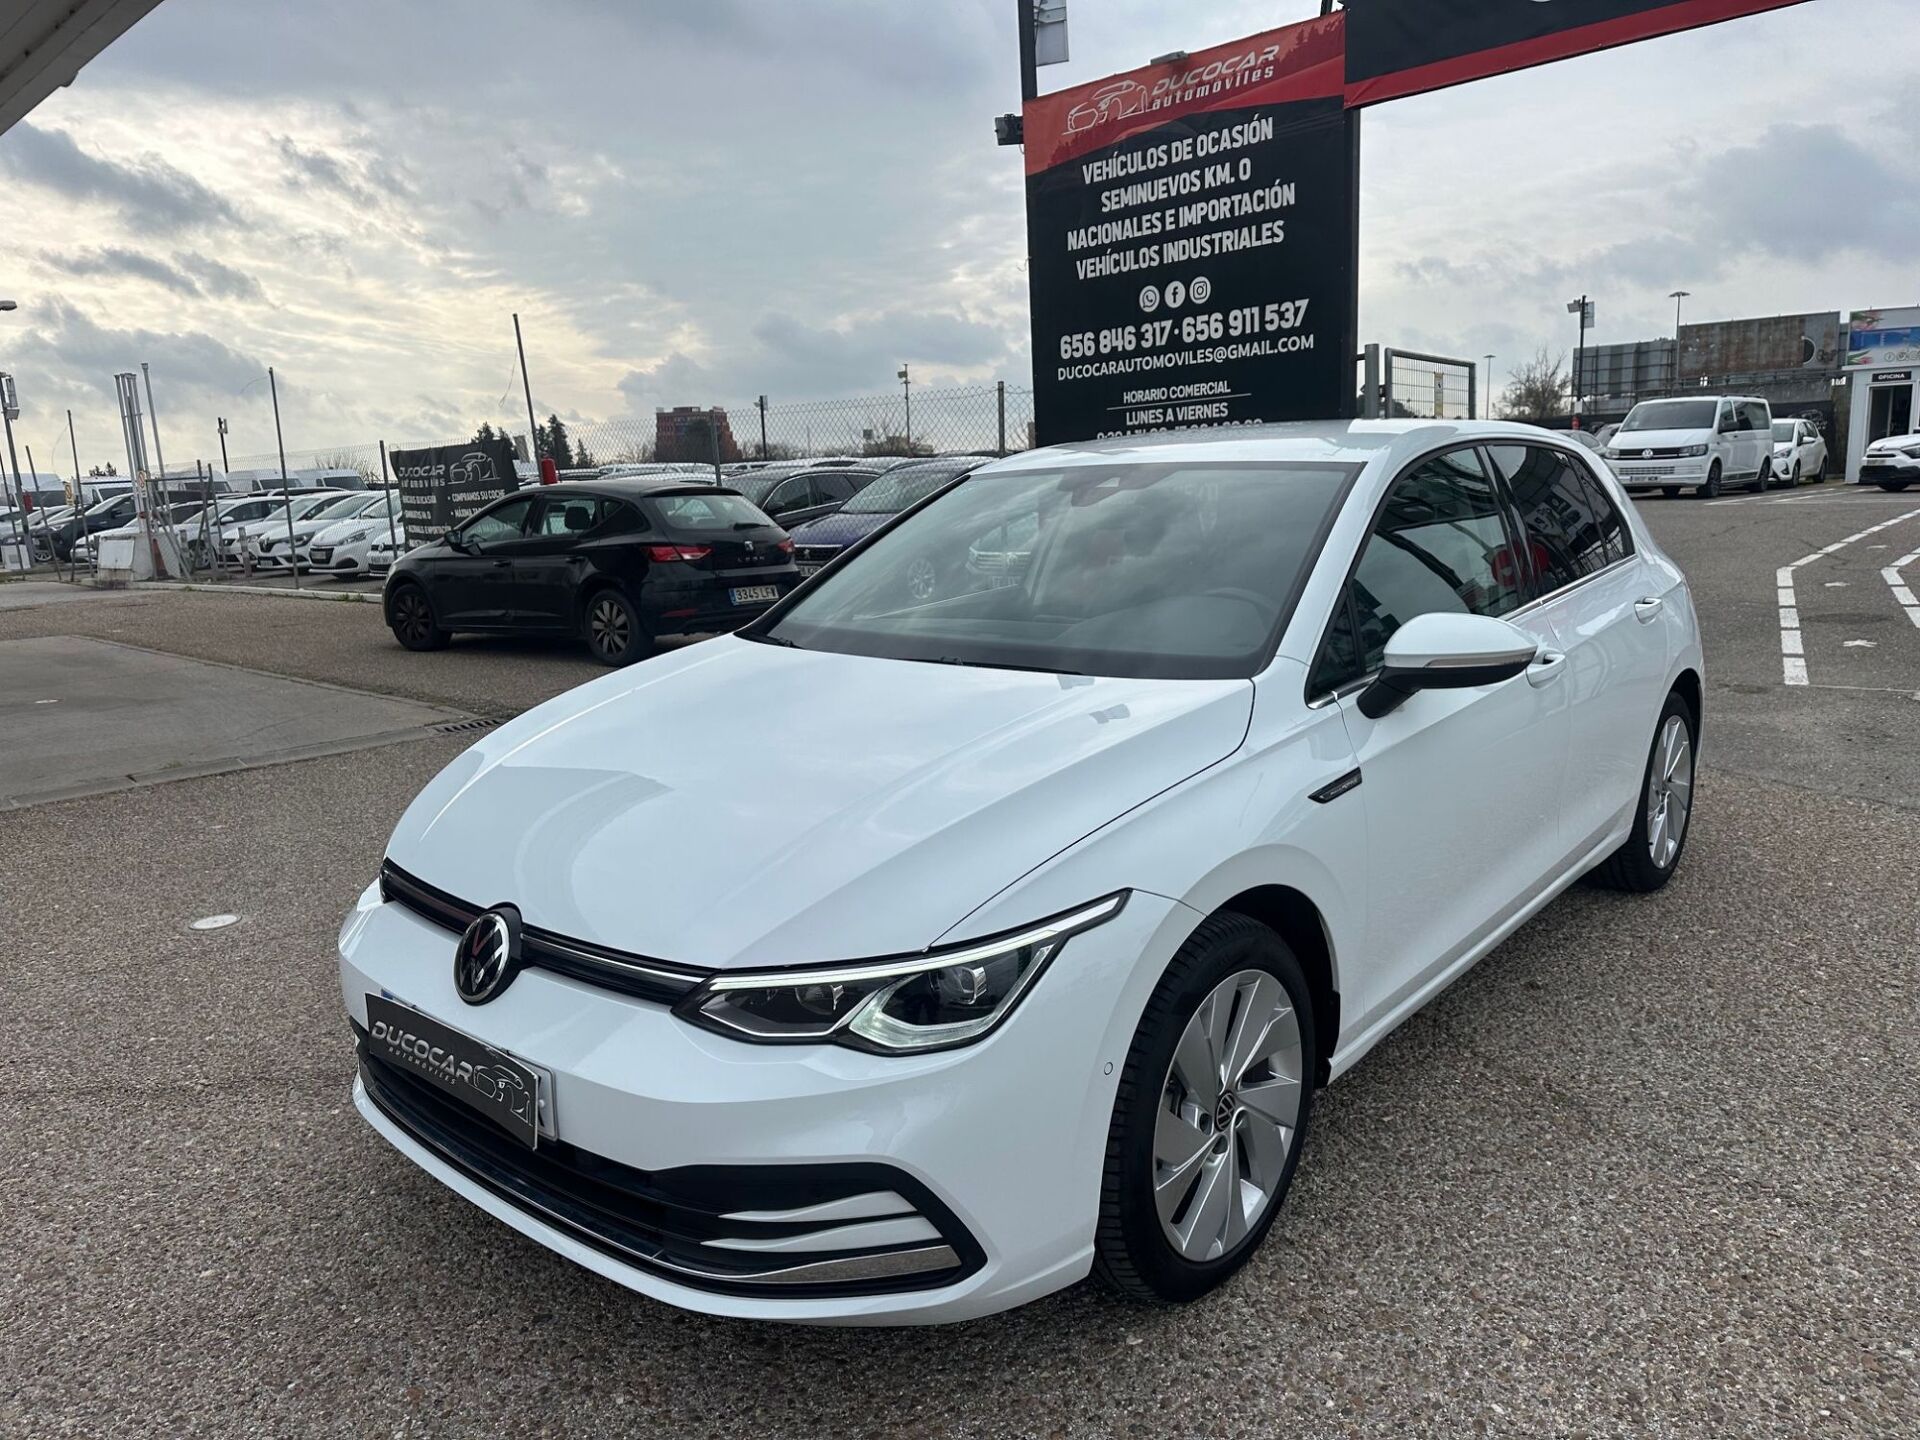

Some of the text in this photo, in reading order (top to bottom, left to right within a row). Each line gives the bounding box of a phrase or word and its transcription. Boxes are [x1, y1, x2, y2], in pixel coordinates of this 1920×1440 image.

[1152, 45, 1280, 96] DUCOCAR
[1152, 65, 1274, 110] automoviles
[1082, 113, 1273, 185] VEHÍCULOS DE OCASIÓN
[1101, 169, 1201, 213] SEMINUEVOS
[1204, 162, 1235, 189] KM.
[1067, 179, 1296, 252] NACIONALES E IMPORTACIÓN
[1076, 220, 1285, 280] VEHÍCULOS INDUSTRIALES
[1060, 331, 1095, 360] 656
[1099, 325, 1137, 354] 846
[1228, 306, 1259, 336] 911
[1264, 299, 1310, 332] 537
[1057, 334, 1314, 381] DUCOCARAUTOMOVILES@GMAIL.COM
[1123, 380, 1231, 404] HORARIO COMERCIAL
[1126, 402, 1229, 426] LUNES A VIERNES
[371, 1020, 475, 1084] DUCOCAR
[389, 1047, 457, 1086] AUTOMOVILES
